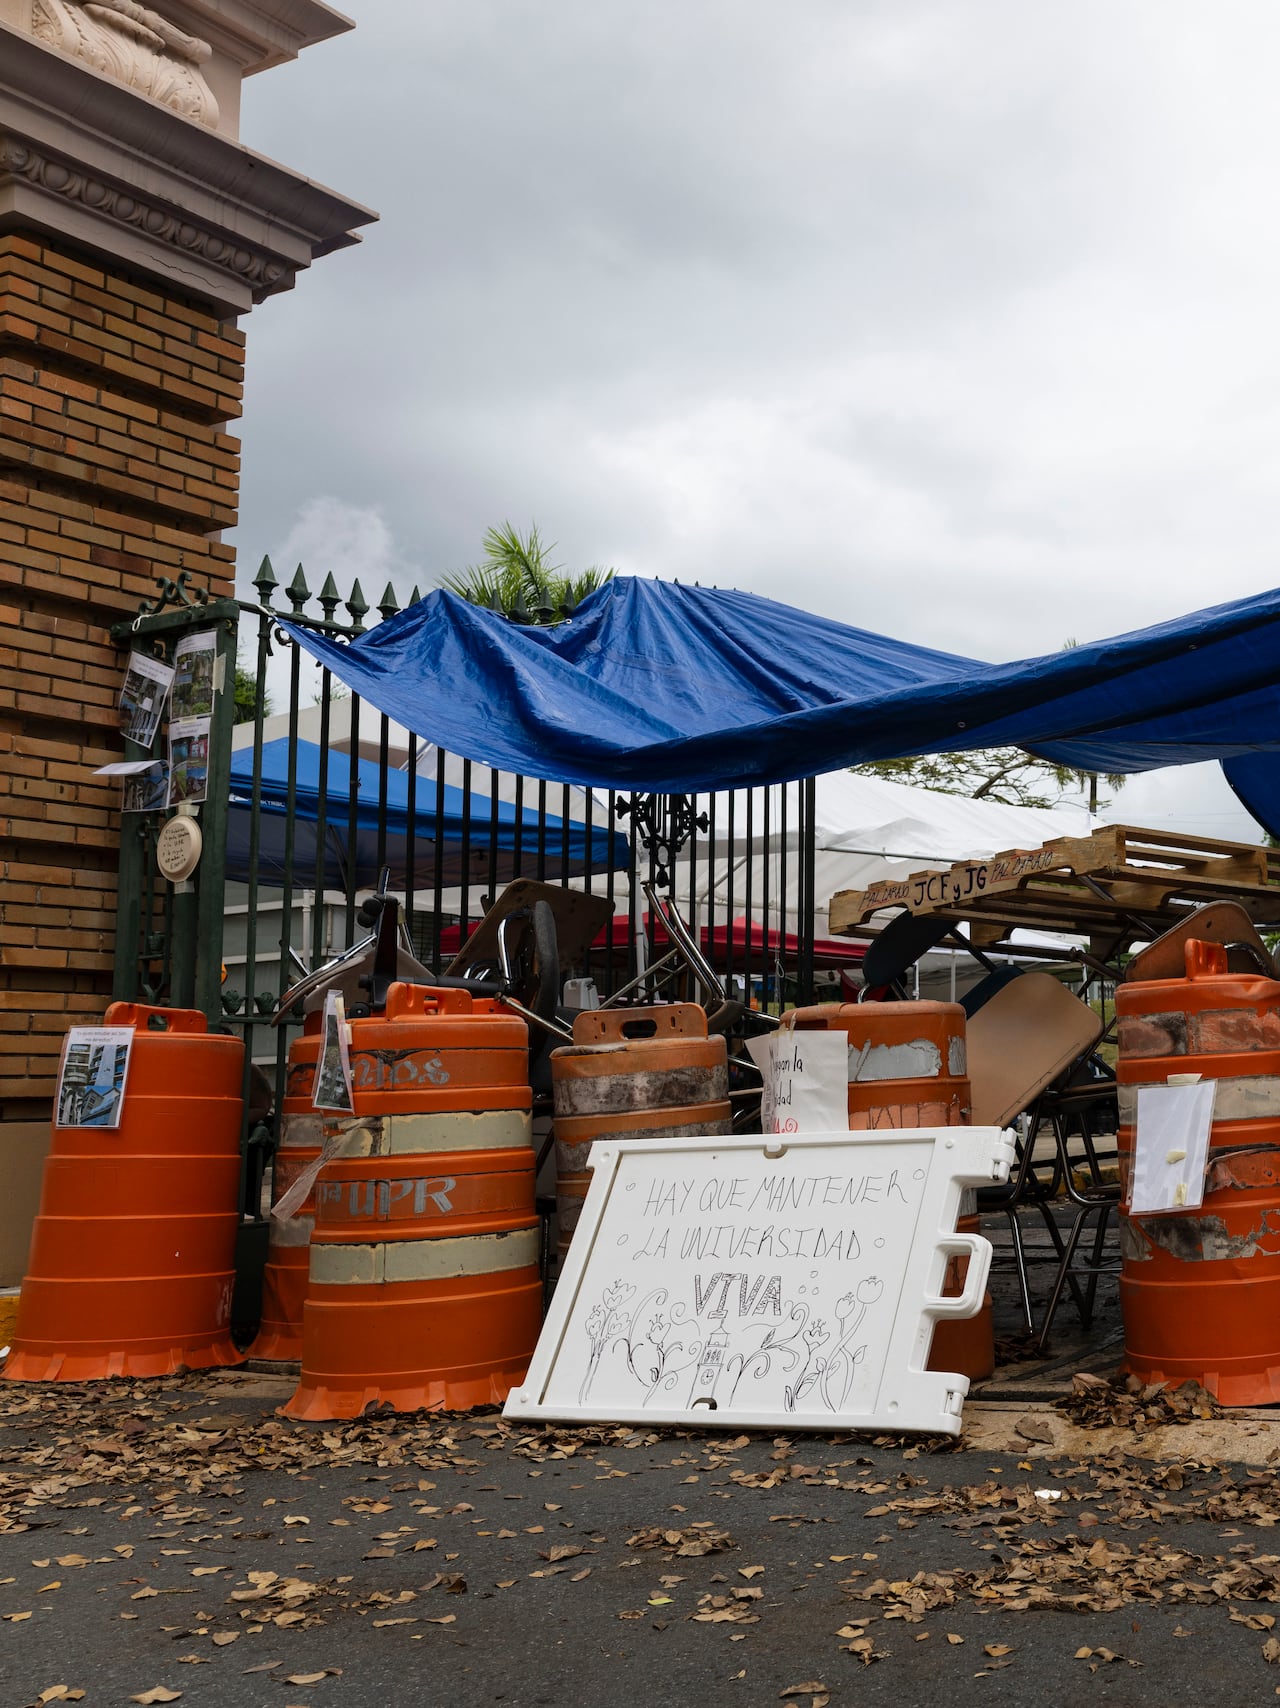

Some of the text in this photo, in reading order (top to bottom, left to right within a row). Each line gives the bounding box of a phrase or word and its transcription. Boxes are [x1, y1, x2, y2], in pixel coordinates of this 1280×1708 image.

[914, 873, 951, 906] JCF
[793, 1045, 803, 1072] la
[348, 1176, 457, 1217] UPR
[644, 1168, 909, 1217] HAY QUE MANTENER
[632, 1225, 862, 1262] LA UNIVERSIDAD
[694, 1272, 783, 1320] VIVA
